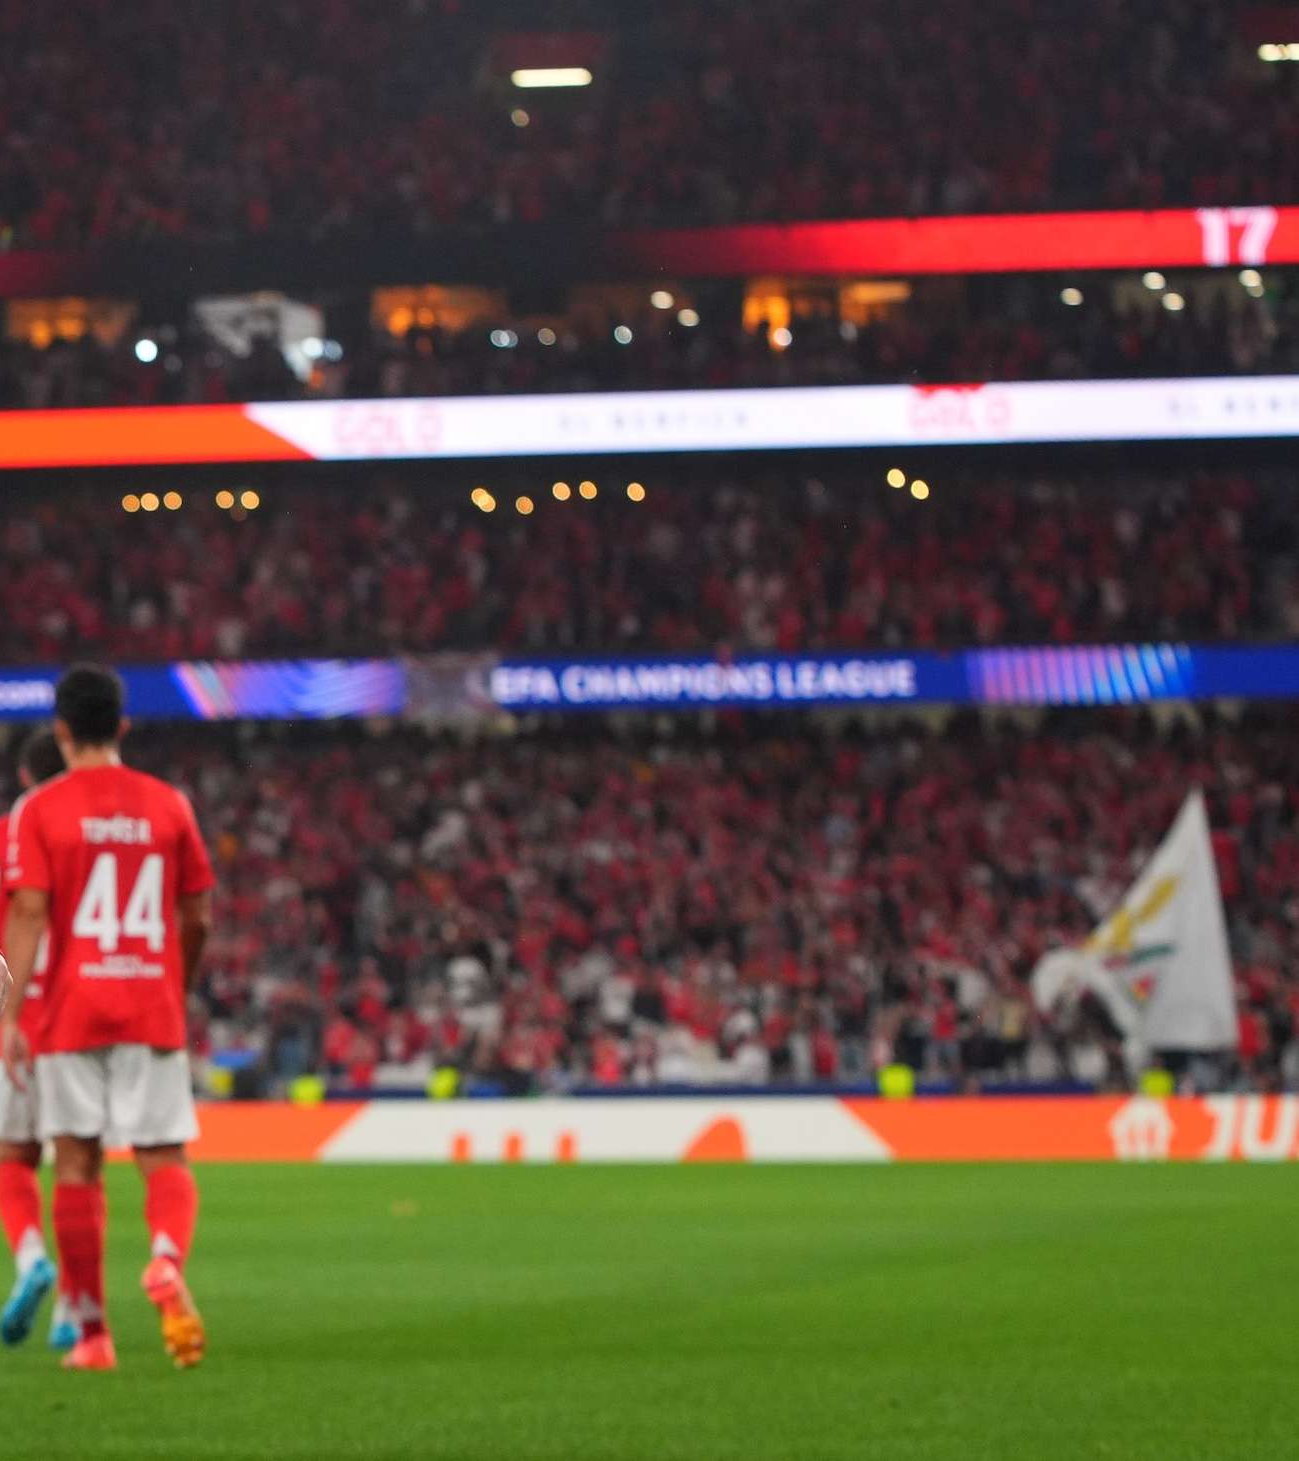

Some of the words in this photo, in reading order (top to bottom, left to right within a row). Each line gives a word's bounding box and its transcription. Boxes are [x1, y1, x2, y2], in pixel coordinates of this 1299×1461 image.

[1195, 205, 1278, 267] 17
[561, 662, 774, 703] CHAMPIONS
[775, 659, 916, 699] LEAGUE
[72, 851, 165, 952] 44
